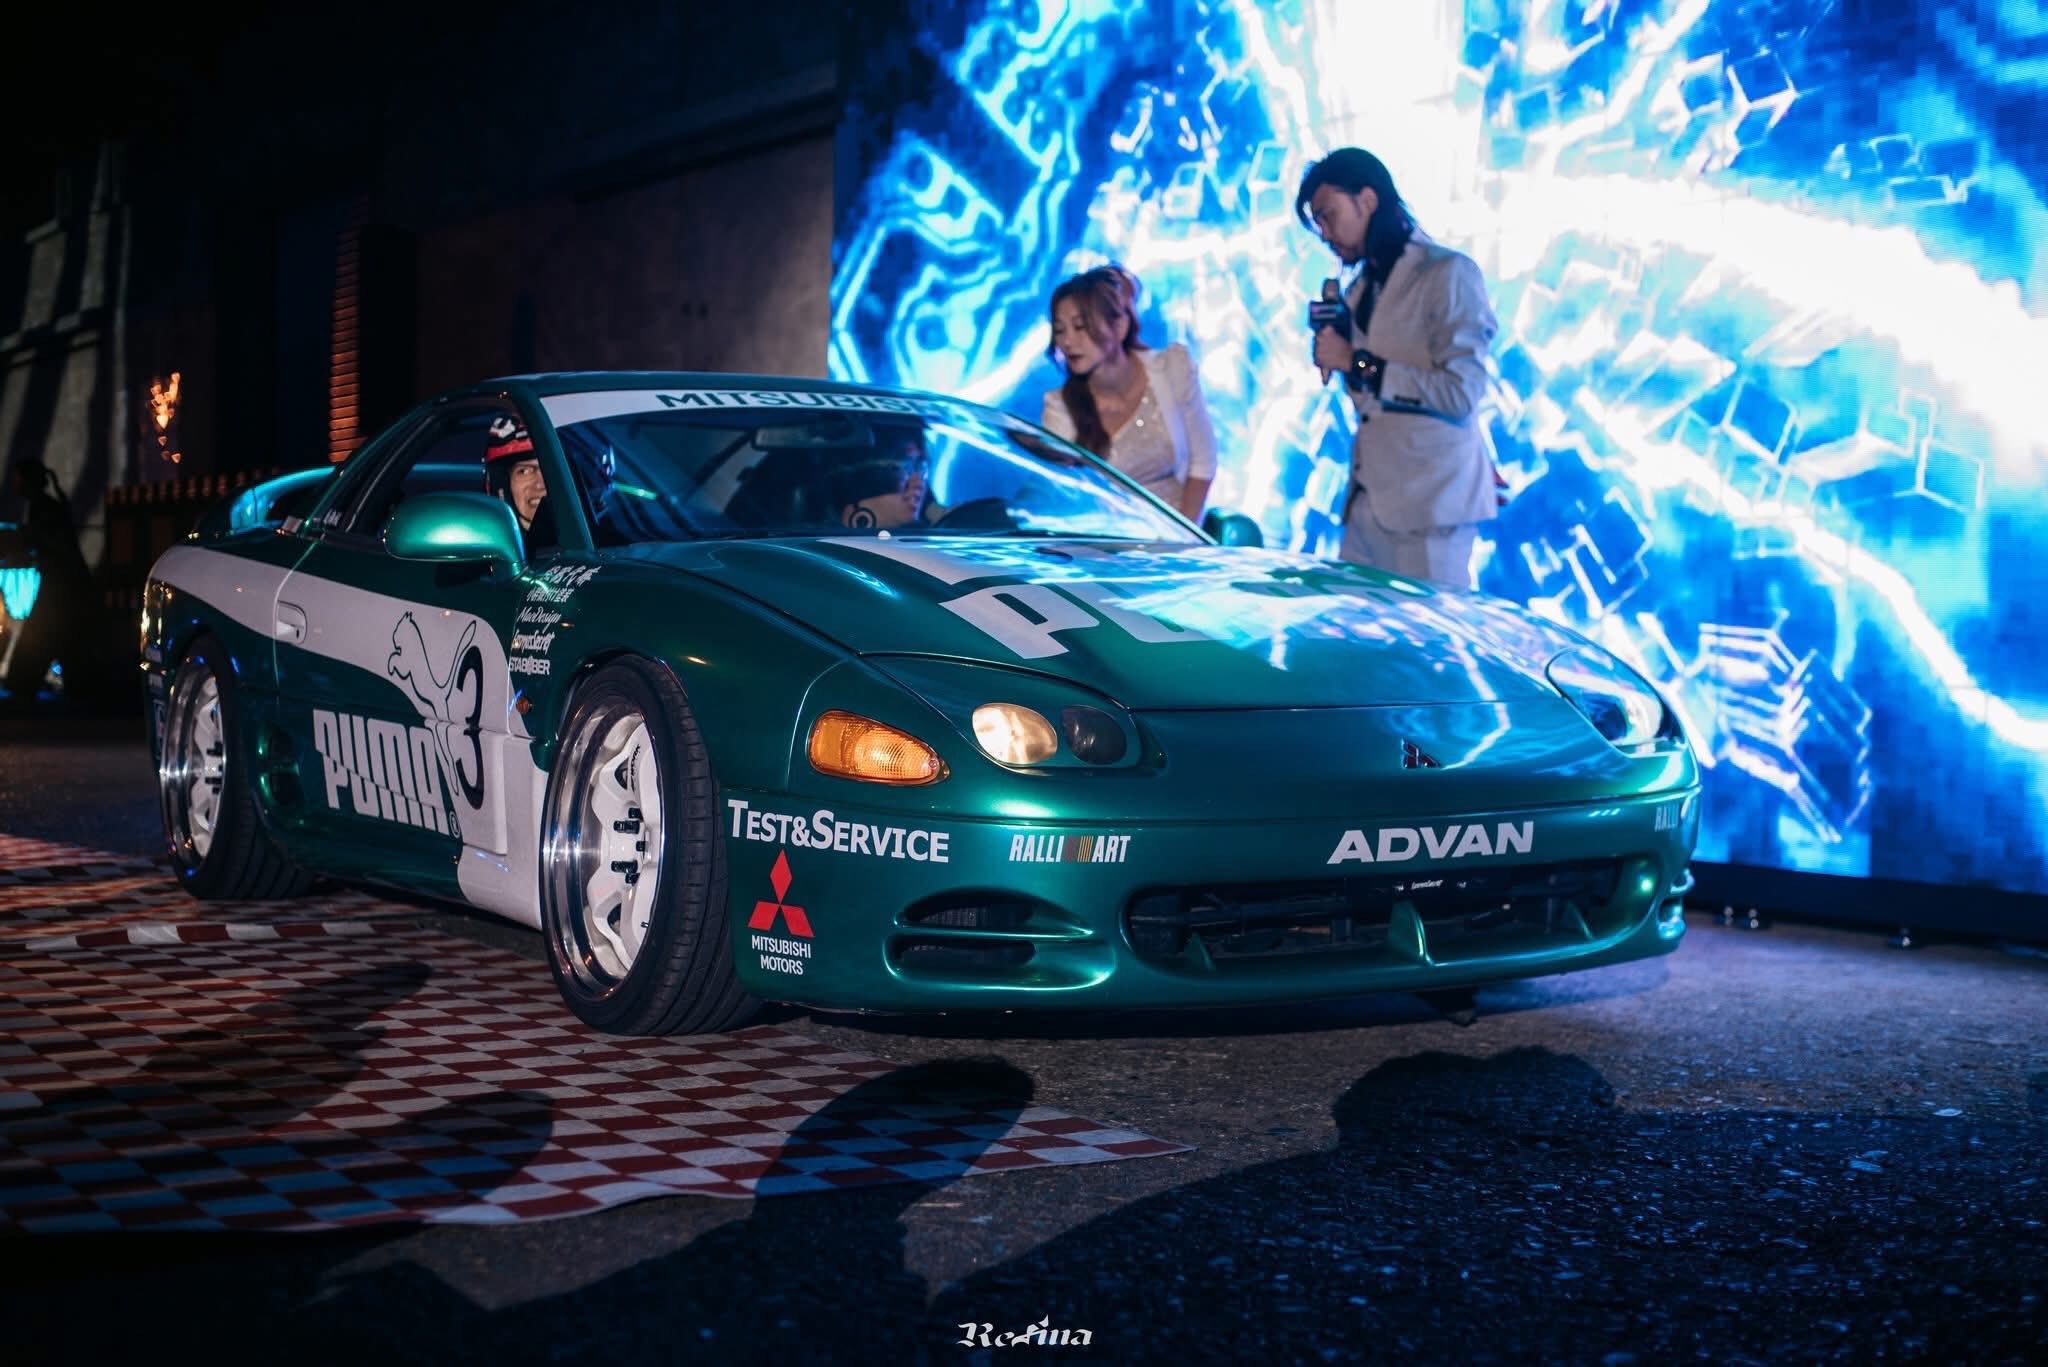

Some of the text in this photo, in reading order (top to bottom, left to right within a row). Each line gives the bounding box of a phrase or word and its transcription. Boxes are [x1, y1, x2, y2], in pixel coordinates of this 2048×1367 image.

[655, 391, 951, 415] MITSUBISH
[456, 645, 485, 810] 3
[312, 708, 451, 836] PUMA
[1326, 820, 1535, 865] ADVAN
[751, 934, 812, 959] MITSUBISHI
[760, 953, 804, 976] MOTORS
